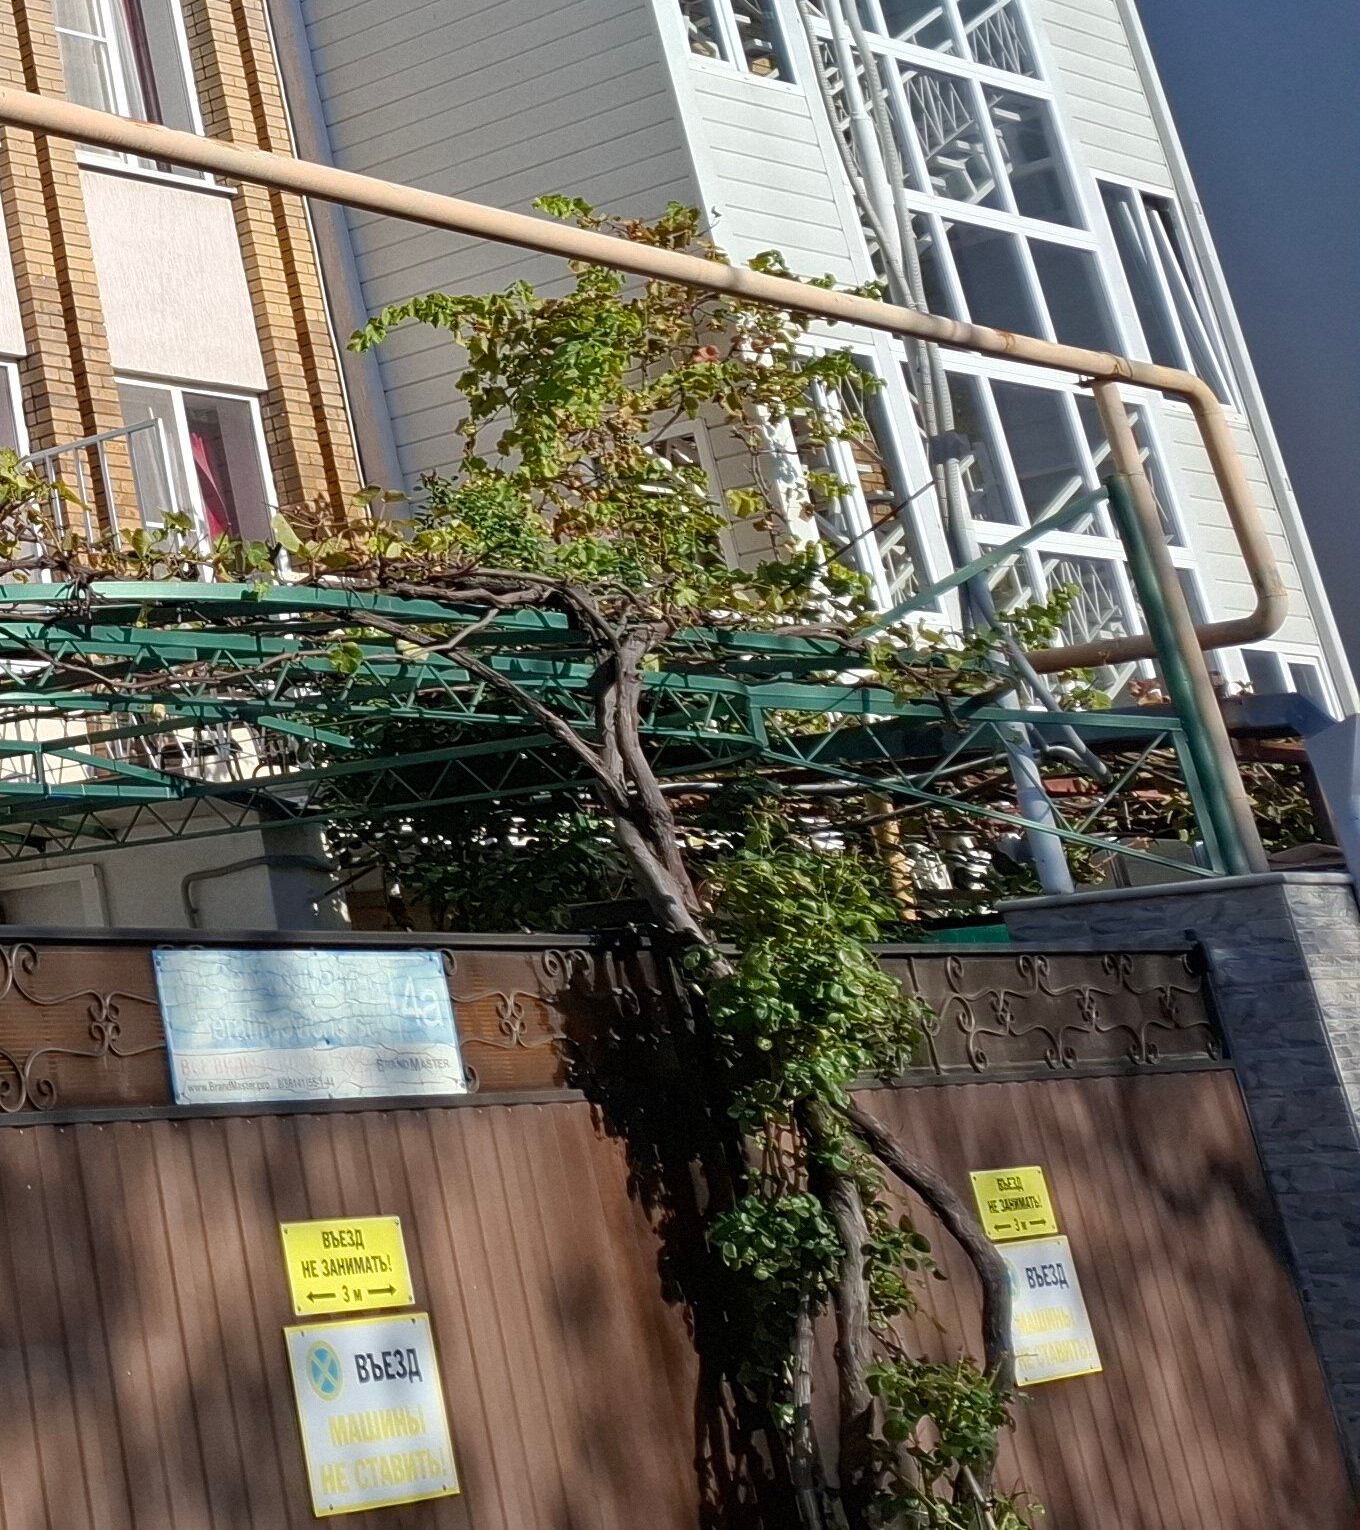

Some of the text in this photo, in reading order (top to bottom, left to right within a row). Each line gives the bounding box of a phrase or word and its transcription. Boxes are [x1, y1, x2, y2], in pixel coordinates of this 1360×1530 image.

[987, 1200, 999, 1213] НЕ
[1013, 1217, 1020, 1231] 3
[321, 1229, 365, 1250] ВЪЕЗД
[301, 1254, 393, 1278] НЕ ЗАНИМАТЬ!
[1025, 1263, 1069, 1289] ВЪЕЗД
[341, 1285, 350, 1303] 3
[354, 1348, 423, 1384] ВЪЕЗД
[329, 1405, 426, 1446] МАШИНЫ
[321, 1462, 349, 1494] НЕ
